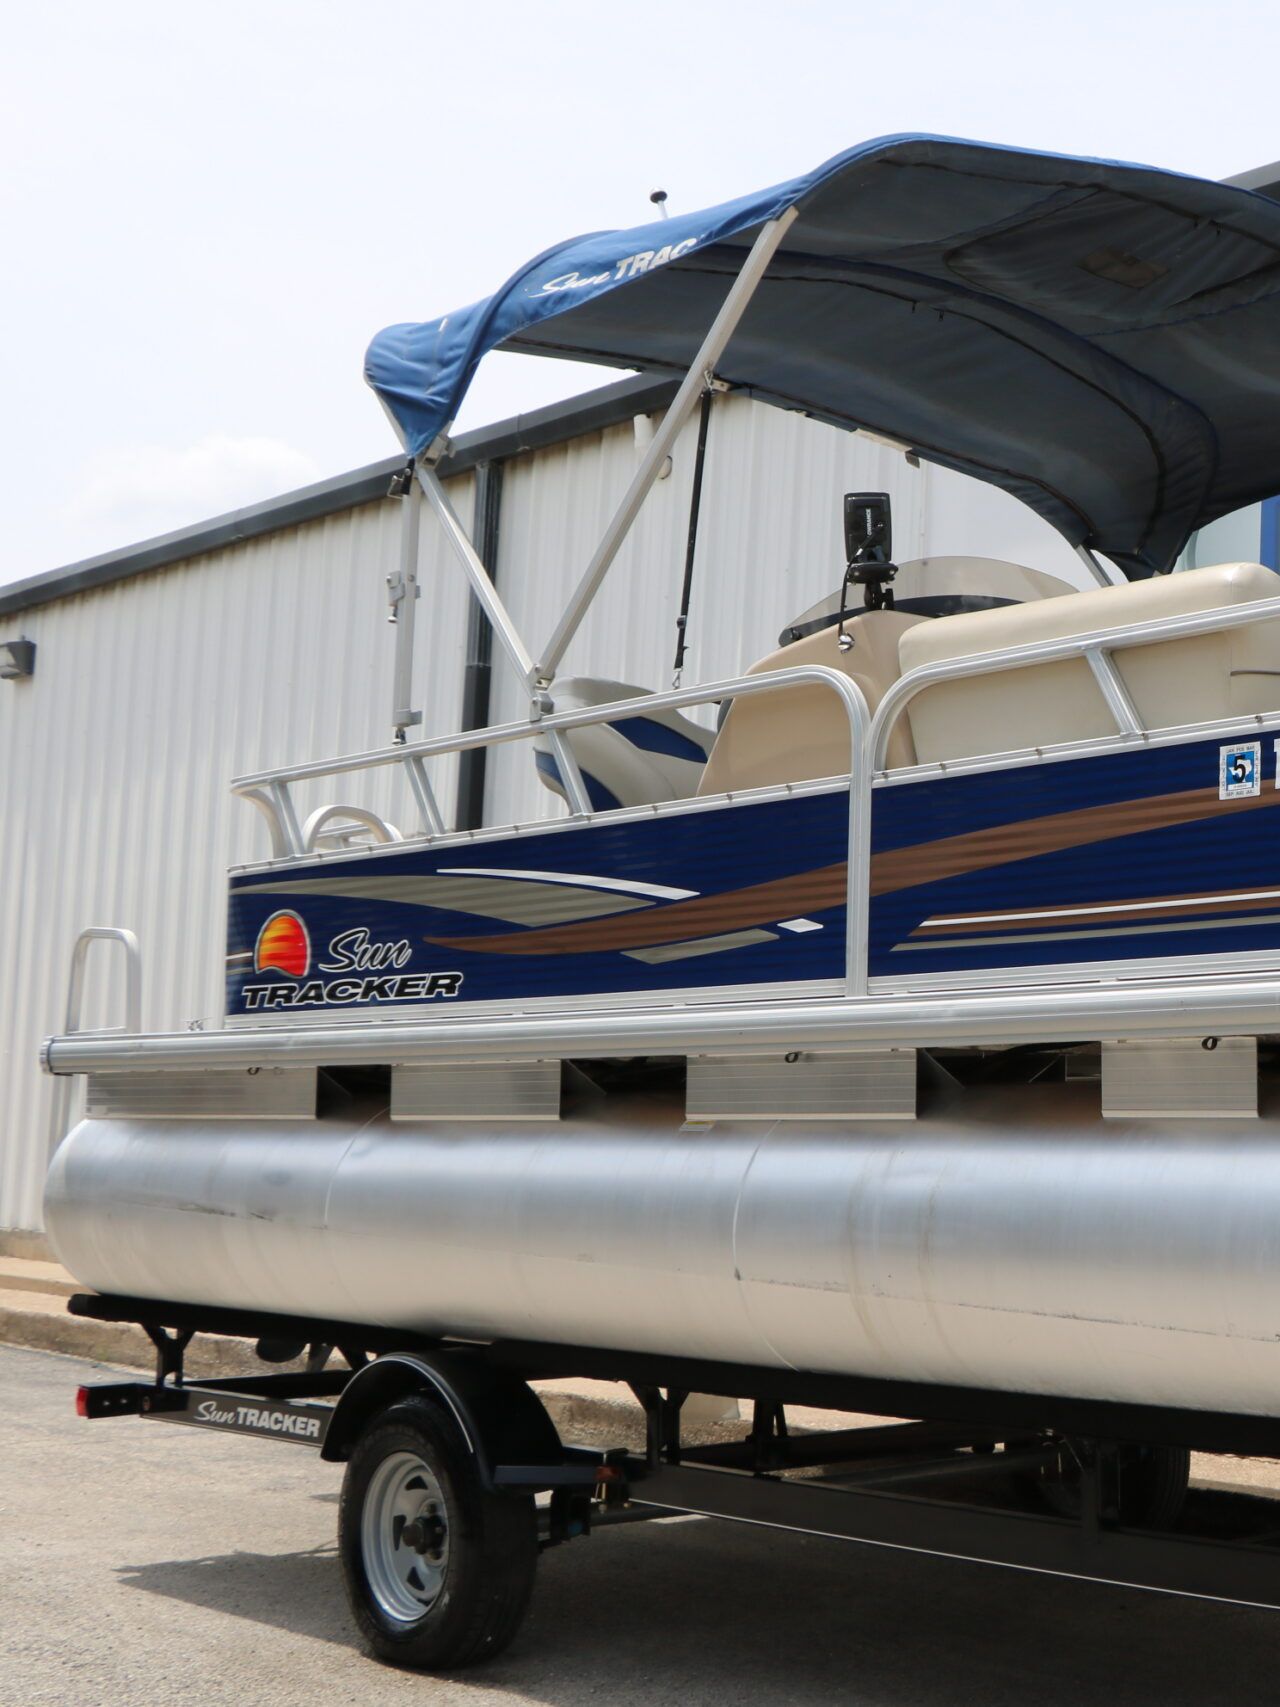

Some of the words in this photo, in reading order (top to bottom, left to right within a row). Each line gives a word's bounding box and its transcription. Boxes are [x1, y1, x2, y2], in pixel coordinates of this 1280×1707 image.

[613, 237, 706, 280] TRAC
[317, 926, 413, 973] Sun
[241, 971, 464, 1010] TRACKER
[193, 1401, 237, 1425] Sun
[236, 1406, 321, 1438] TRACKER
